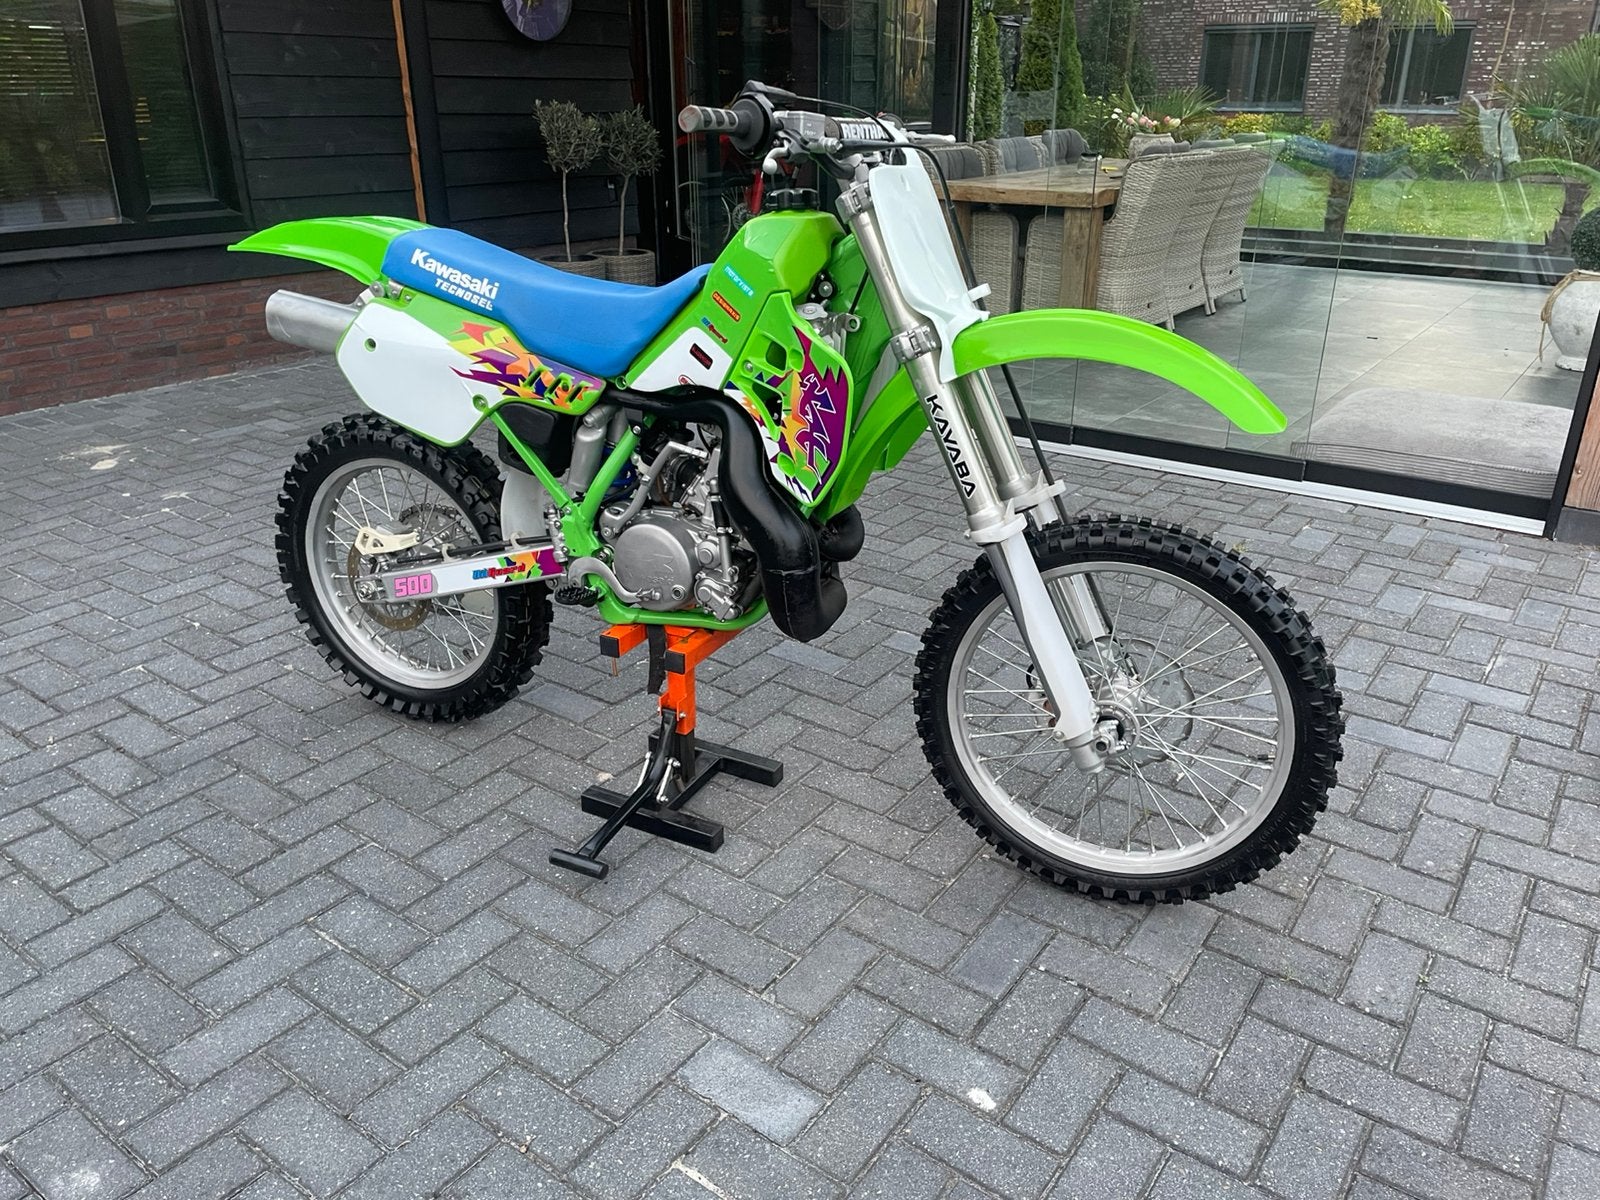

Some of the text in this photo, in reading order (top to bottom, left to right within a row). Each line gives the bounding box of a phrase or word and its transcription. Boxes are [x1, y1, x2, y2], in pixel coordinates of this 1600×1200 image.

[841, 122, 891, 139] RENTHA
[411, 248, 500, 300] Kawasaki
[394, 573, 433, 598] 500
